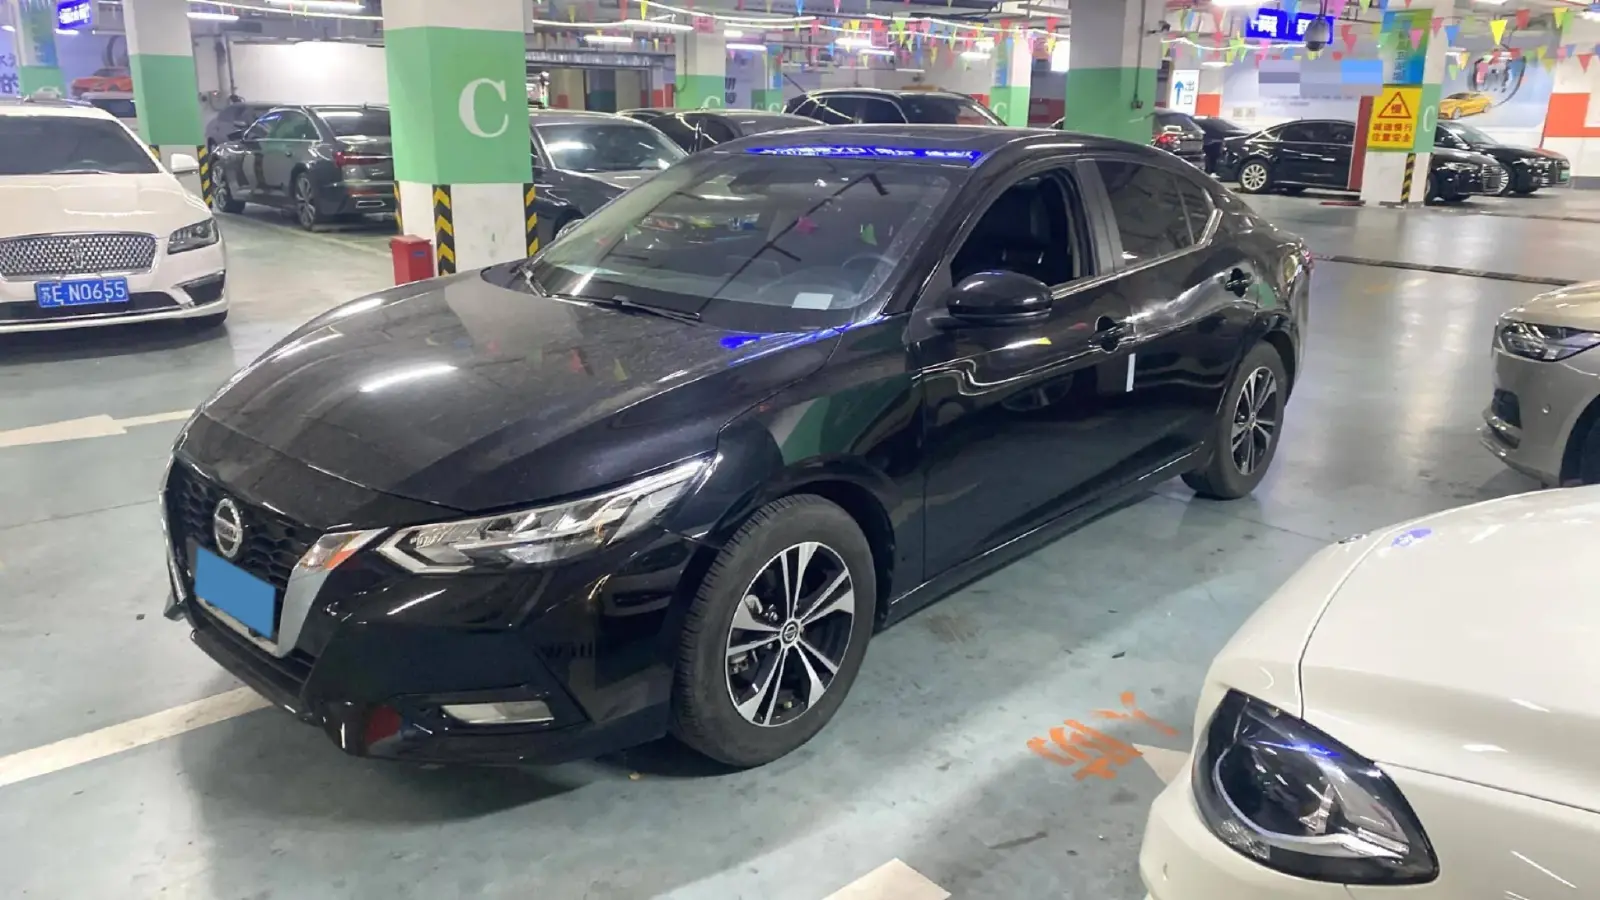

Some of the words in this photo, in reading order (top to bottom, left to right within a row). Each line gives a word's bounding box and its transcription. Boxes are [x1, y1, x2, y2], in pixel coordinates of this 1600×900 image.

[459, 78, 508, 137] C
[1423, 105, 1436, 132] C
[1371, 133, 1412, 142] 注意安全
